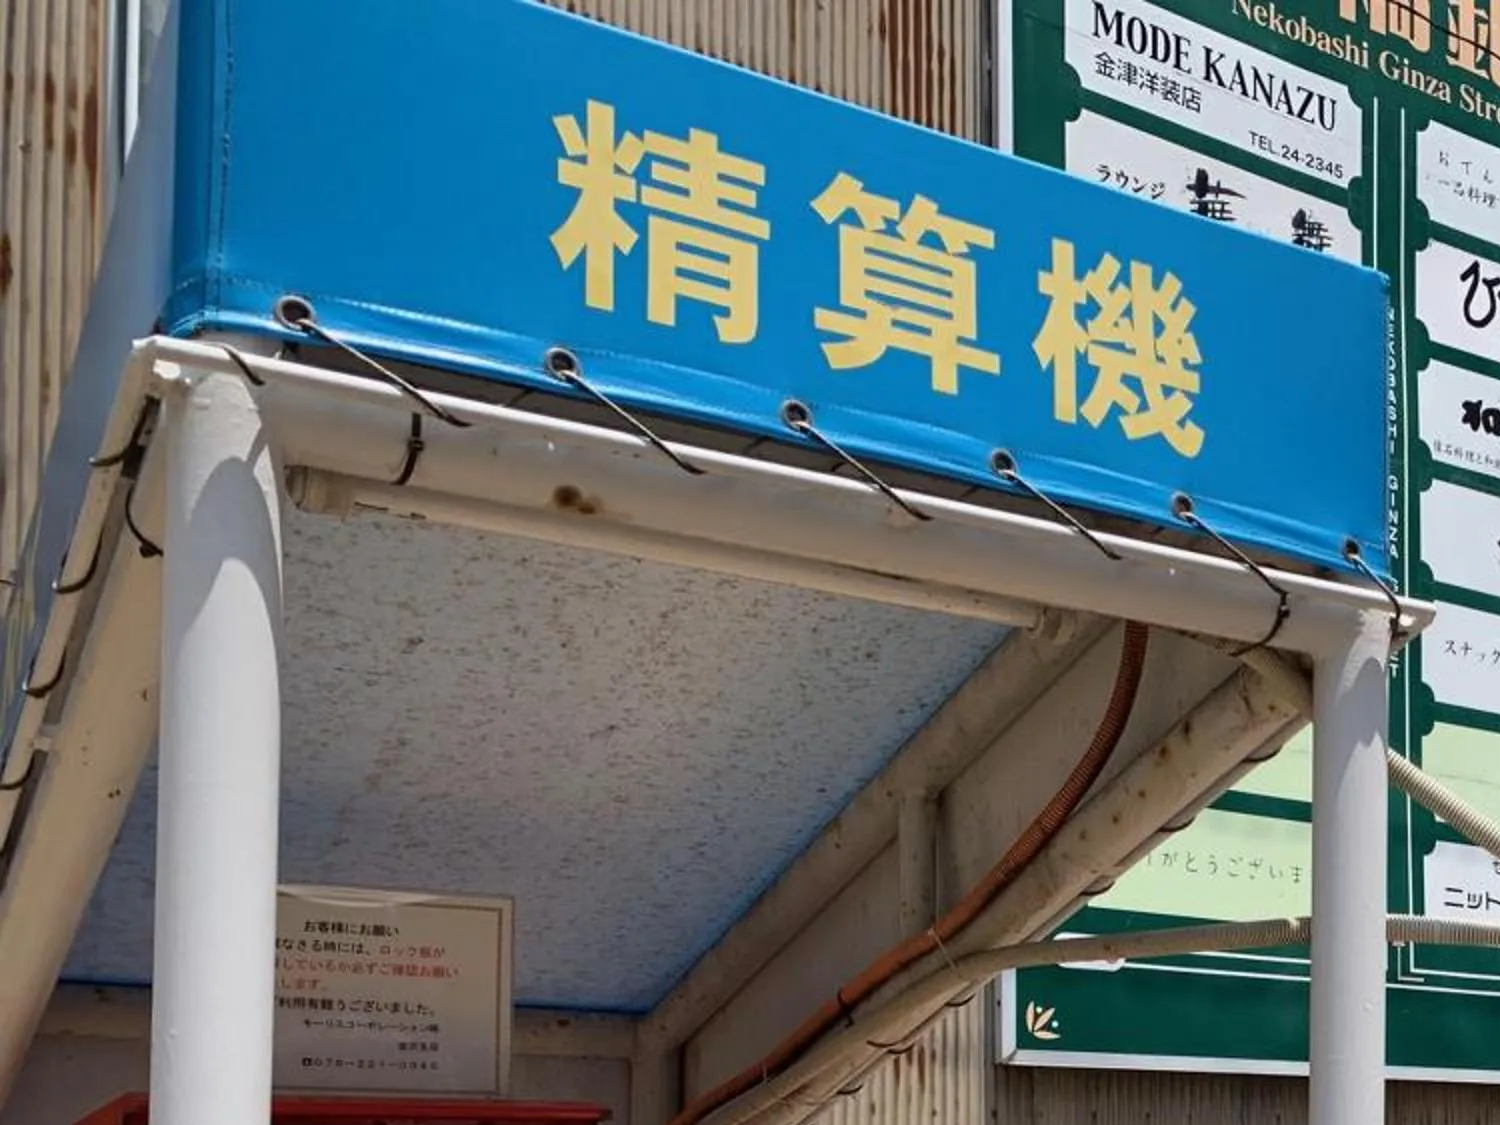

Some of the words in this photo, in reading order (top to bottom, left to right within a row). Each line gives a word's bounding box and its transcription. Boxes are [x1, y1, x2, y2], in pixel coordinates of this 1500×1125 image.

[1091, 2, 1192, 74] MODE
[1202, 45, 1338, 131] KANAZU
[1095, 51, 1201, 113] 金津洋装店
[1232, 0, 1369, 70] Nekobashi
[1379, 50, 1451, 103] Ginza
[1096, 165, 1167, 200] ラウンジ
[549, 98, 1206, 460] 精算機
[304, 920, 400, 938] お客様にお願い
